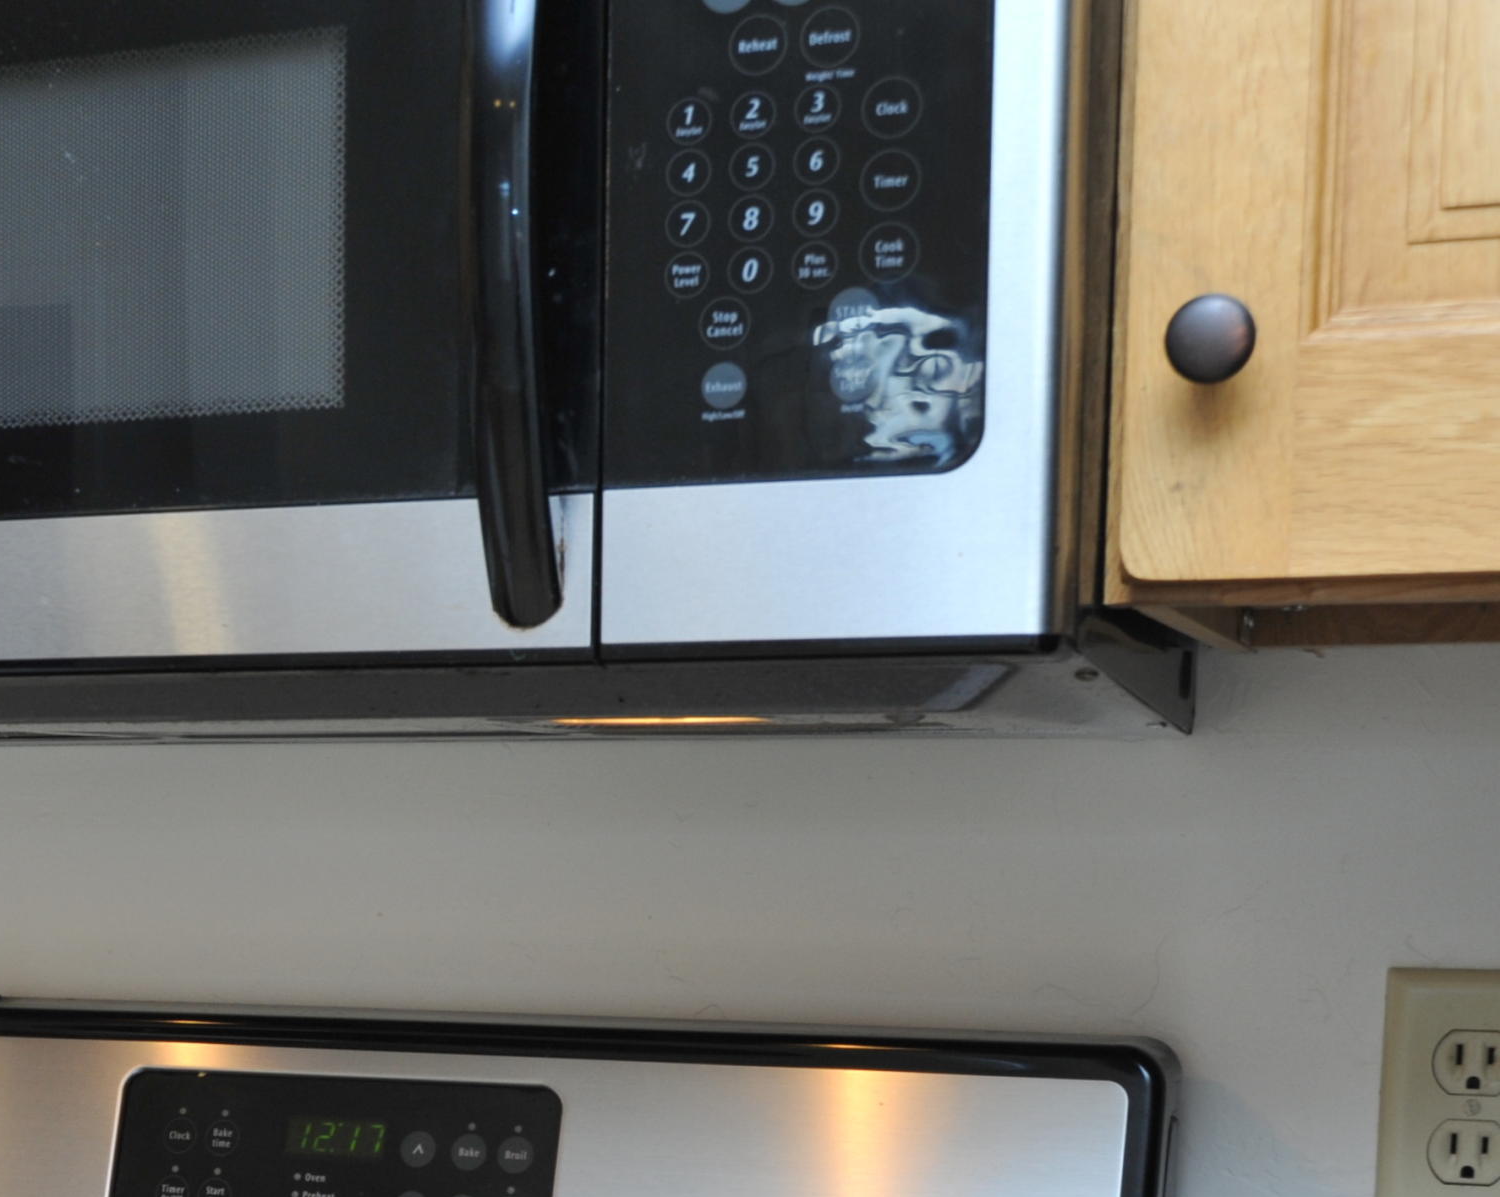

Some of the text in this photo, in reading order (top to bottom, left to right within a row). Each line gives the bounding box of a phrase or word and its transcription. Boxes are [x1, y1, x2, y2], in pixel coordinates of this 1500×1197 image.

[738, 37, 778, 53] Reheat
[808, 29, 852, 46] Defrost
[745, 97, 761, 120] 2
[810, 90, 826, 113] 3
[875, 100, 909, 116] Clock
[683, 104, 695, 126] 1
[745, 155, 760, 178] 5
[809, 150, 824, 172] 6
[681, 162, 696, 184] 4
[873, 174, 908, 189] Timer
[742, 206, 760, 231] 8
[807, 200, 825, 225] 9
[680, 212, 696, 236] 7
[874, 239, 904, 254] Cook
[874, 255, 904, 269] Time
[672, 264, 702, 276] Power
[741, 257, 759, 283] 0
[674, 276, 699, 288] Level
[712, 311, 738, 325] Stop
[706, 323, 744, 338] Cancel
[169, 1131, 191, 1141] Clock
[213, 1128, 233, 1138] Bake
[212, 1139, 231, 1148] time
[458, 1147, 480, 1158] Bake
[504, 1150, 528, 1160] Broil
[304, 1173, 326, 1183] Oven
[161, 1184, 185, 1194] Timer
[206, 1186, 225, 1196] Start
